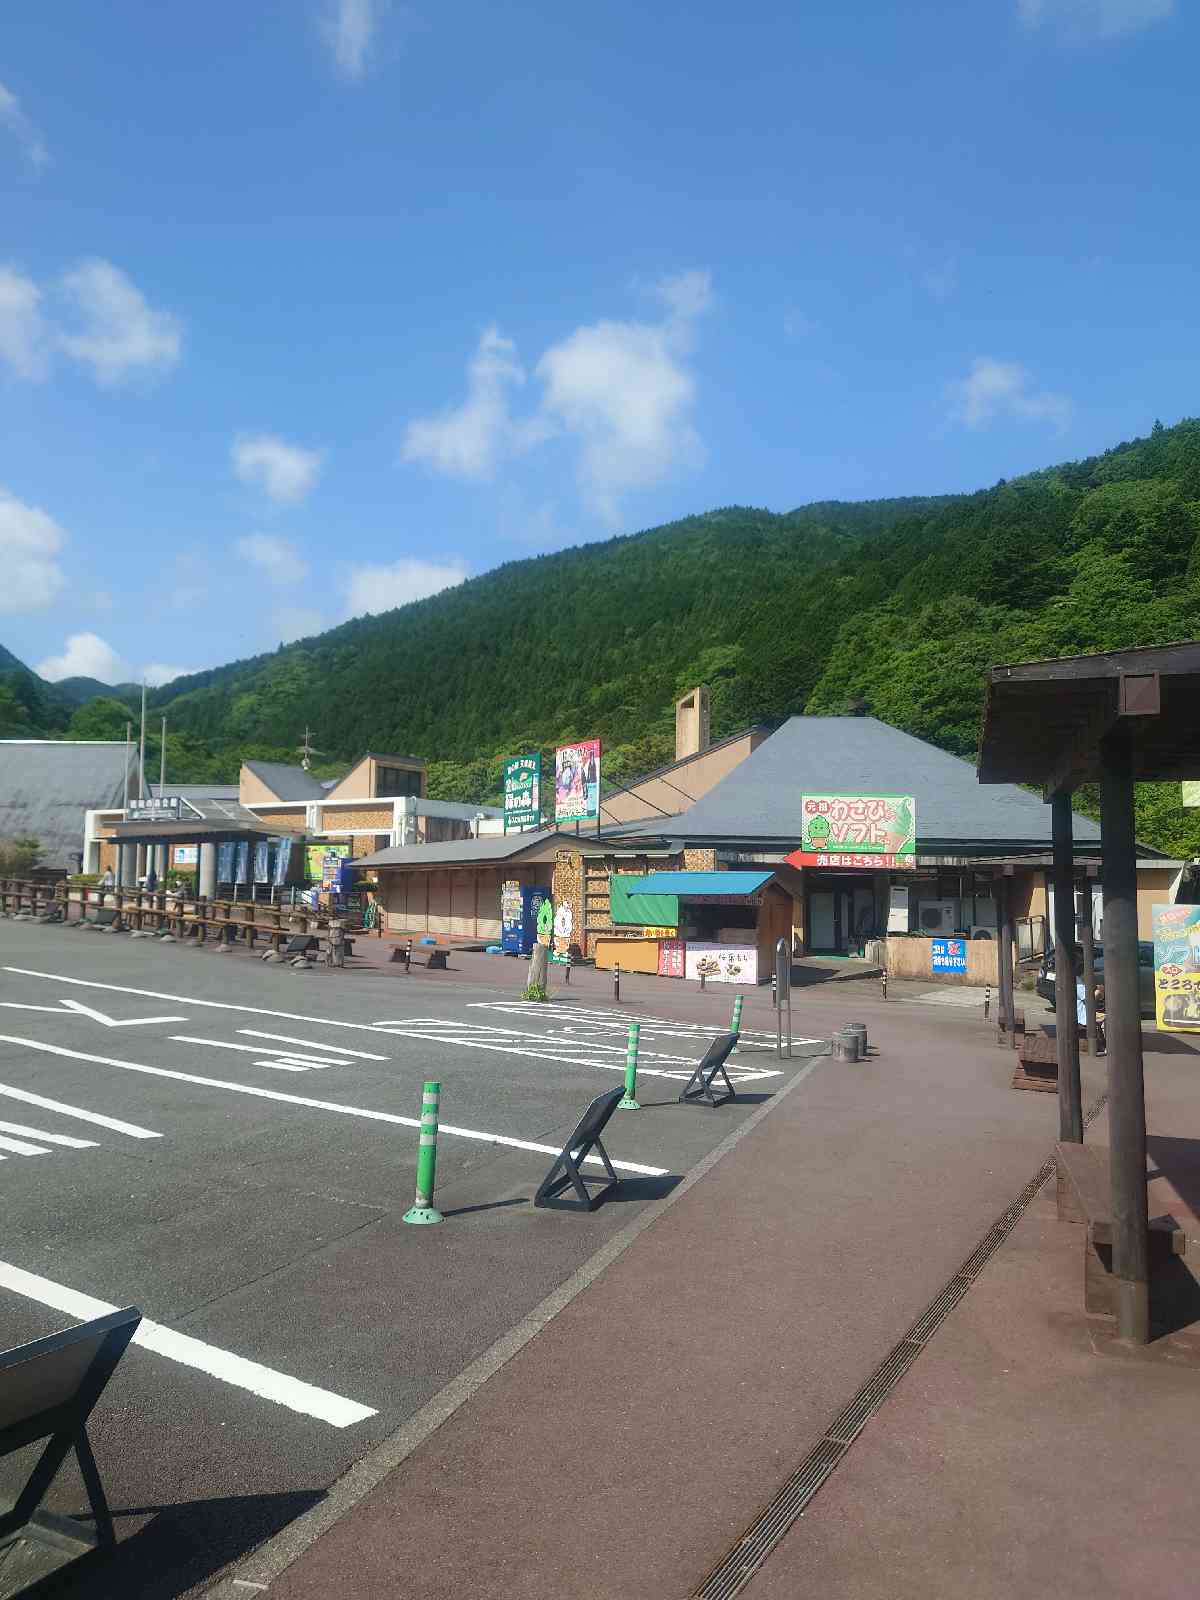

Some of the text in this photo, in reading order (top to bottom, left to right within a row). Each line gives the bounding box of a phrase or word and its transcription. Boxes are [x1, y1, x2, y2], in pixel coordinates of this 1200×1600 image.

[831, 799, 886, 820] わさび
[832, 822, 887, 843] ソフト
